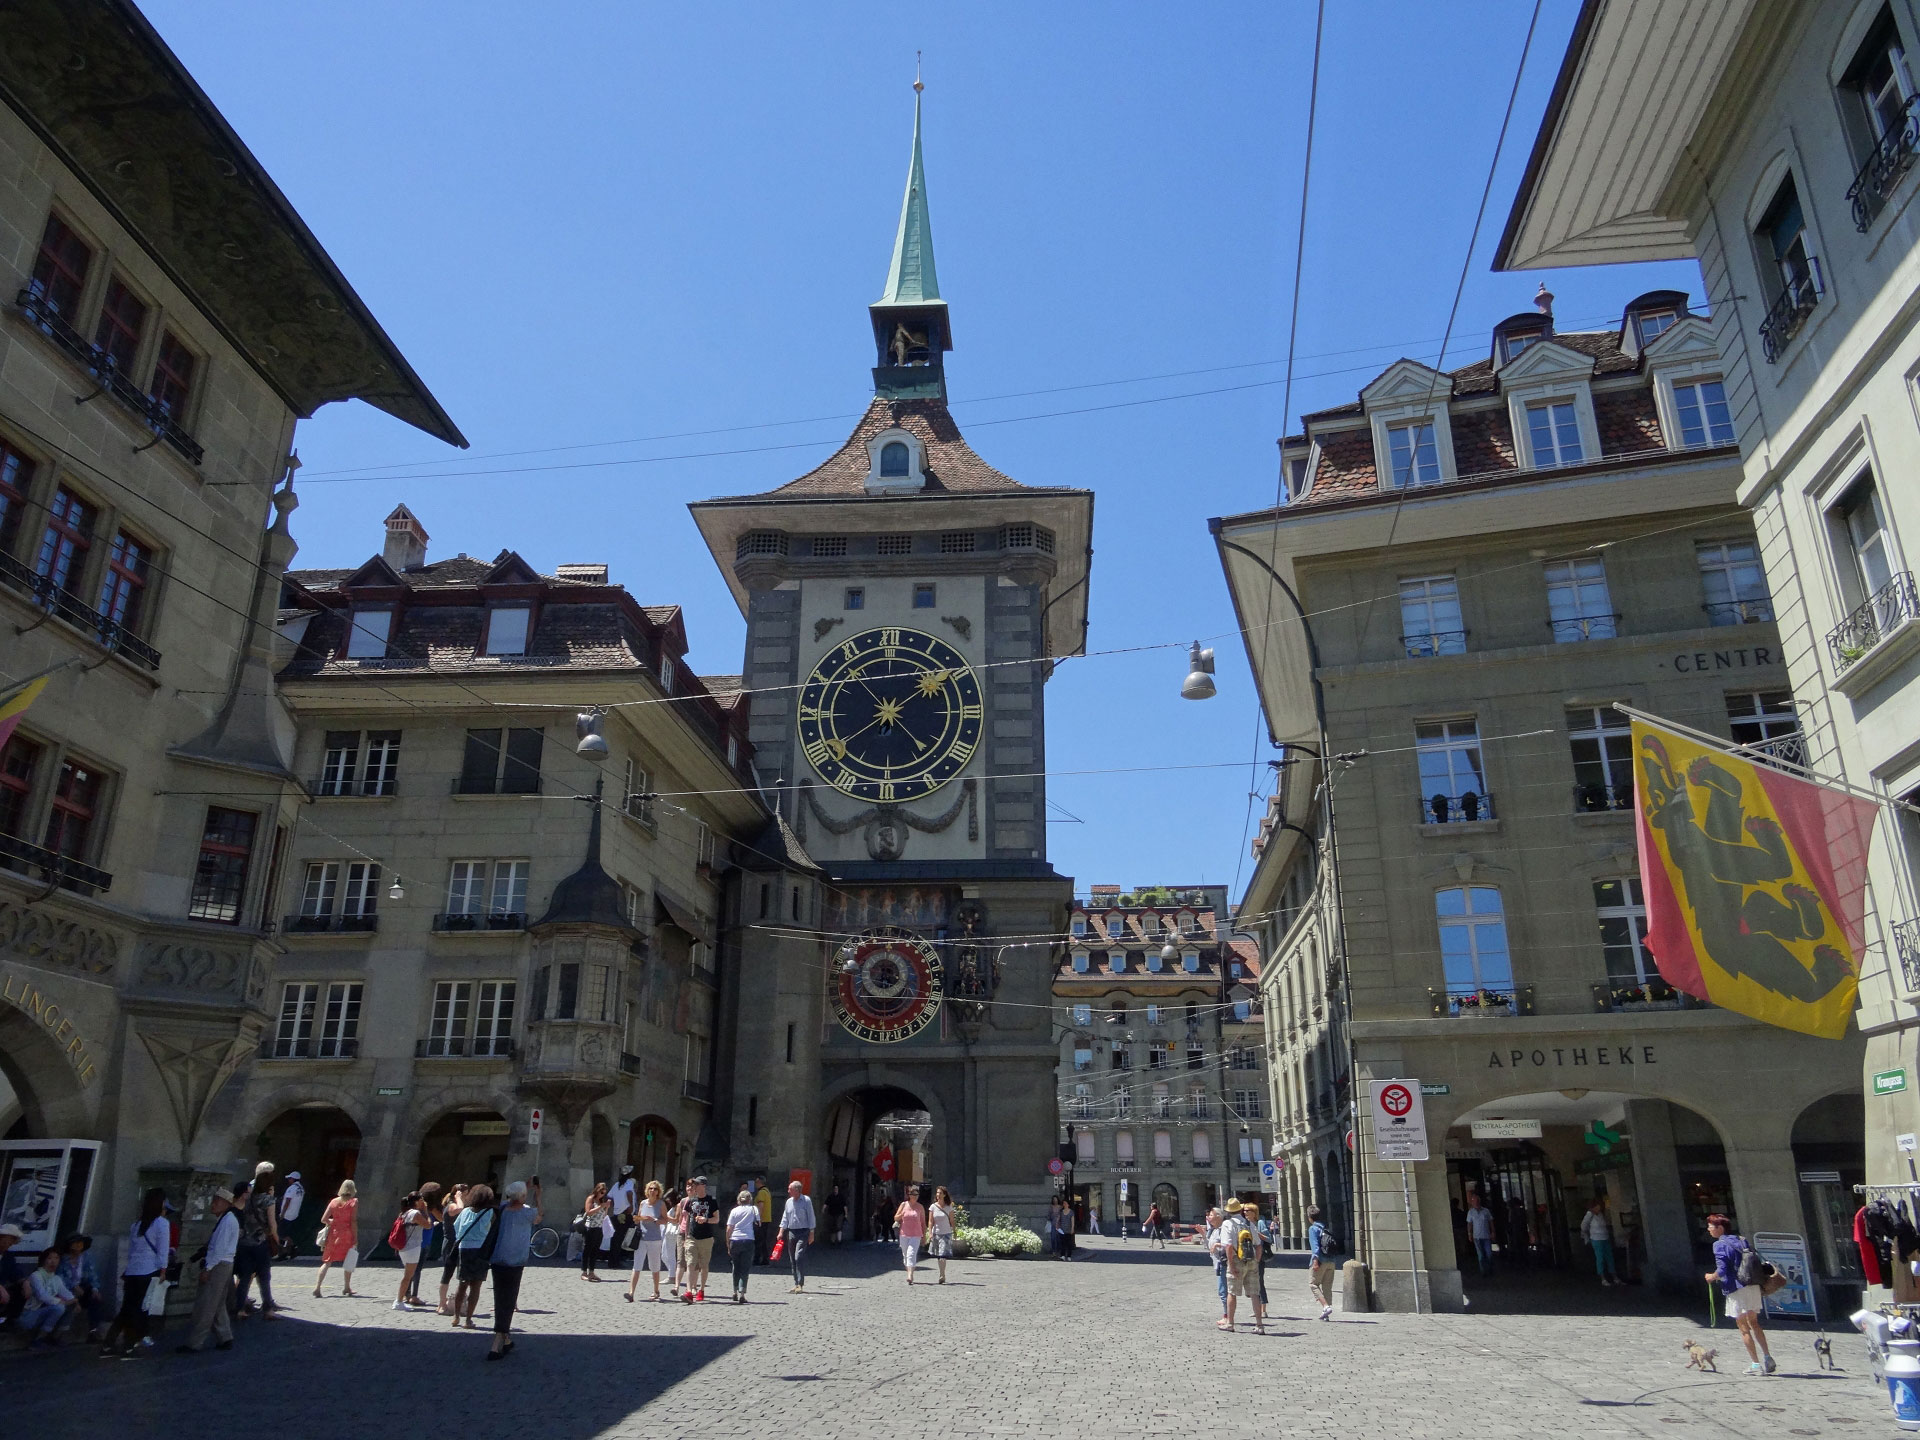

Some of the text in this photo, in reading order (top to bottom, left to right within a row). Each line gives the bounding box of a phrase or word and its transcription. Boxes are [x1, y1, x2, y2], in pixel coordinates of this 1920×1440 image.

[879, 629, 900, 646] XII
[1488, 1046, 1657, 1068] APOTHEKE
[1473, 1122, 1538, 1130] CENTRAL-APOTHEKE
